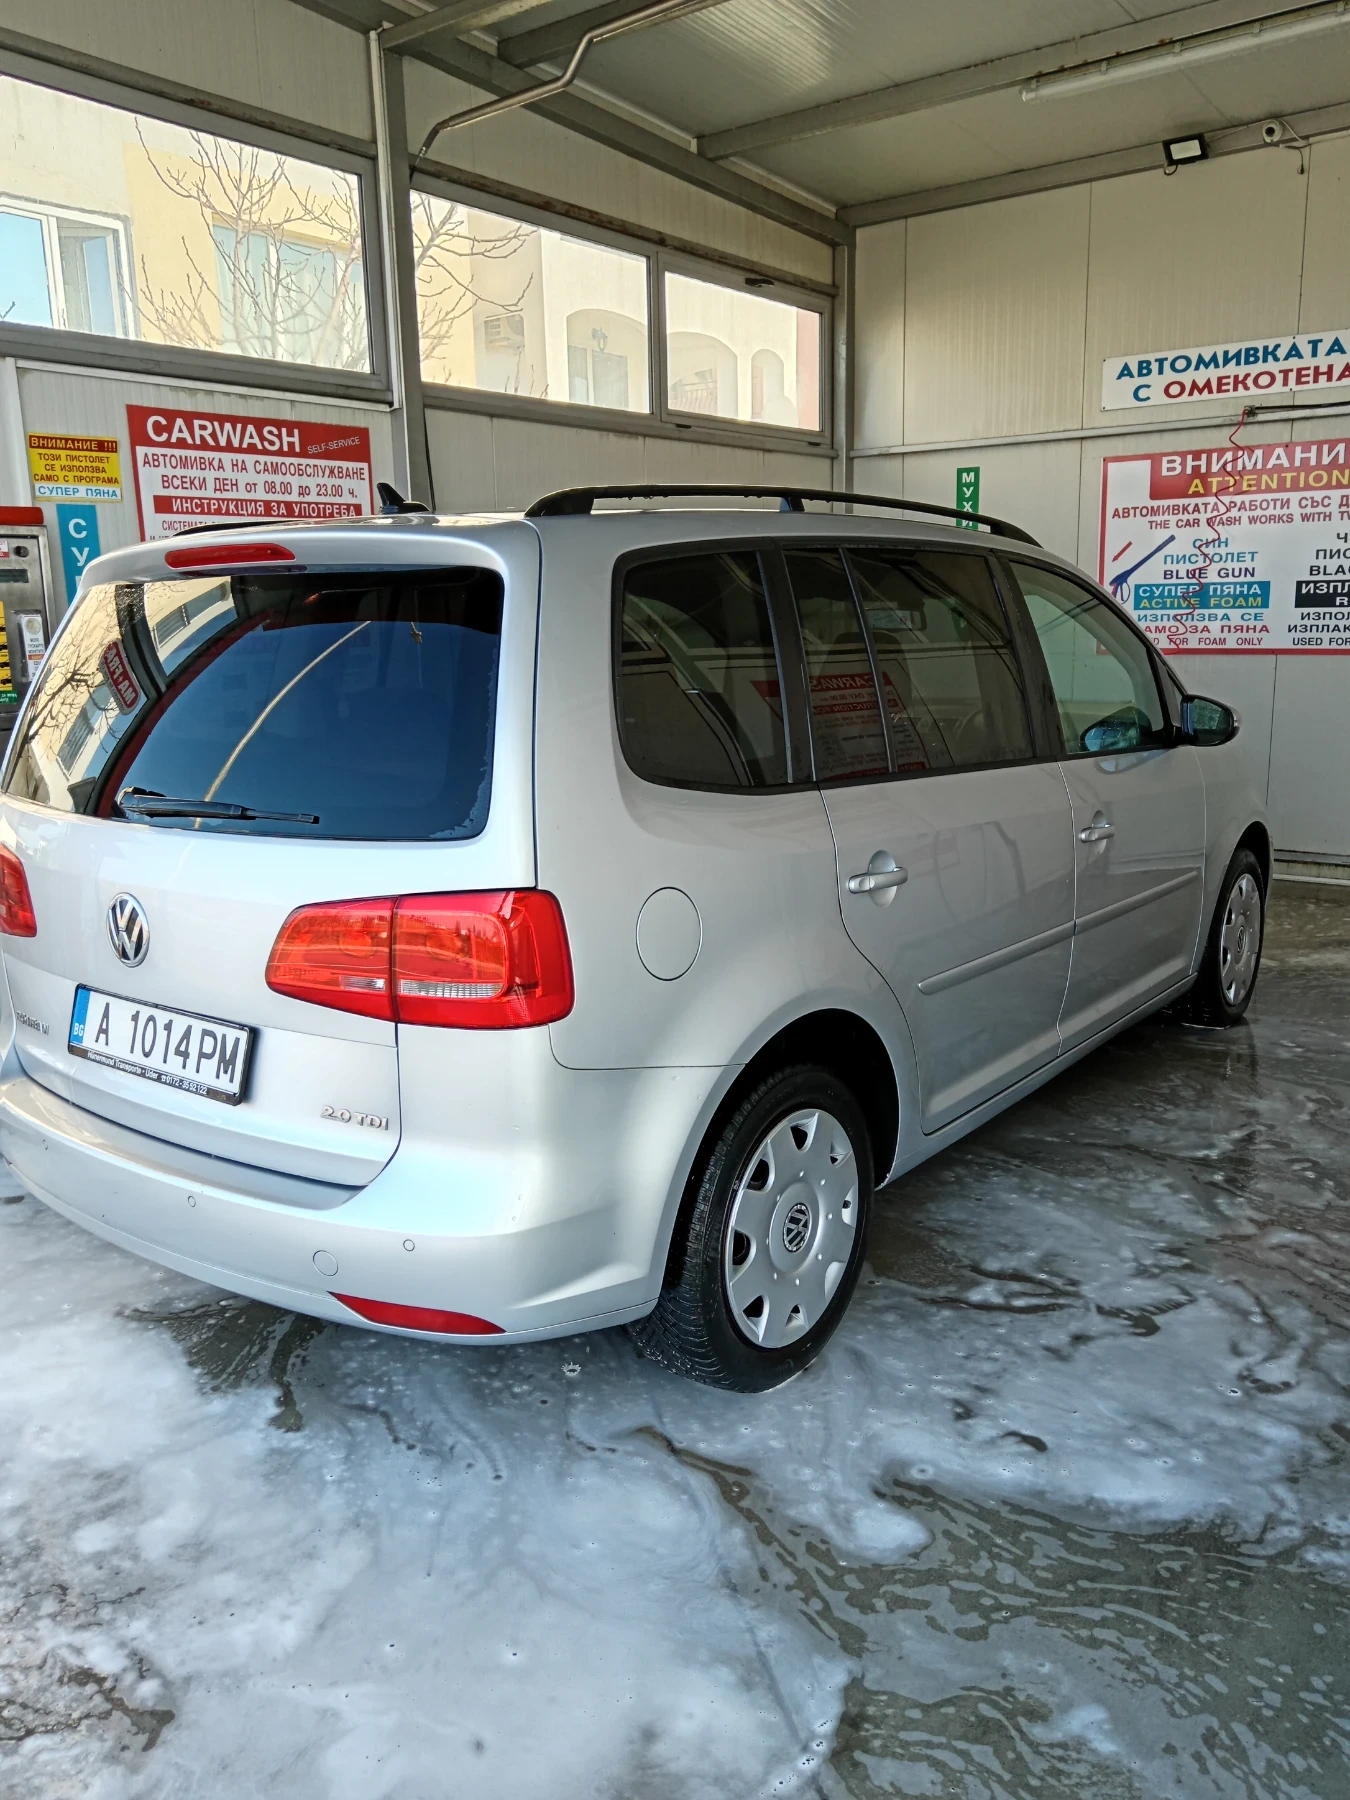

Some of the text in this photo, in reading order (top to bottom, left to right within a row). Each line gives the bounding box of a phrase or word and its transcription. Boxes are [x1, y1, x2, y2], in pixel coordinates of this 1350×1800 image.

[1116, 337, 1348, 380] АВТОМИВКАТА
[1133, 361, 1350, 402] С ОМЕКОТЕНА
[146, 415, 300, 453] CARWASH
[31, 437, 98, 450] ВНИМАНИЕ
[307, 436, 361, 454] SELF-SERVICE
[38, 453, 110, 464] ТОЗИ ПИСТОЛЕТ
[44, 463, 107, 474] СЕ ИЗПОЛЗВА
[142, 452, 366, 481] АВТОМИВКА НА САМООБСЛУЖВАНЕ
[34, 474, 119, 485] САМО С ПРОГРАМА
[161, 474, 207, 491] ВСЕКИ
[214, 477, 239, 494] ДЕН
[245, 482, 258, 493] от
[264, 480, 292, 495] 08.00
[298, 485, 311, 498] до
[316, 483, 343, 498] 23.00
[1187, 468, 1350, 495] ATTENTION
[38, 486, 118, 498] СУПЕР ПЯНА
[172, 498, 357, 517] ИНСТРУКЦИЯ ЗА УПОТРЕБА
[1112, 501, 1220, 519] АВТОМИВКАТА
[1228, 497, 1291, 513] РАБОТИ
[1148, 519, 1170, 530] THE
[1175, 518, 1201, 529] CAR
[1206, 515, 1242, 527] WASH
[1247, 513, 1294, 525] WORKS
[1300, 511, 1332, 522] WITH
[1192, 537, 1229, 549] СИН
[1163, 551, 1258, 565] ПИСТОЛЕТ
[1163, 567, 1256, 580] BLUE GUN
[1139, 584, 1262, 597] СУПЕР ПЯНА
[1139, 597, 1262, 609] ACTIVE FOAM
[1137, 612, 1264, 623] ИЗПОЛЗВА СЕ
[1144, 624, 1270, 634] АМО ЗА ПЯНА
[1168, 637, 1189, 646] FOR
[1198, 637, 1227, 646] FOAM
[1236, 637, 1263, 646] ONLY
[1292, 637, 1323, 646] USED
[73, 1022, 85, 1037] BG
[353, 1112, 389, 1131] TDI
